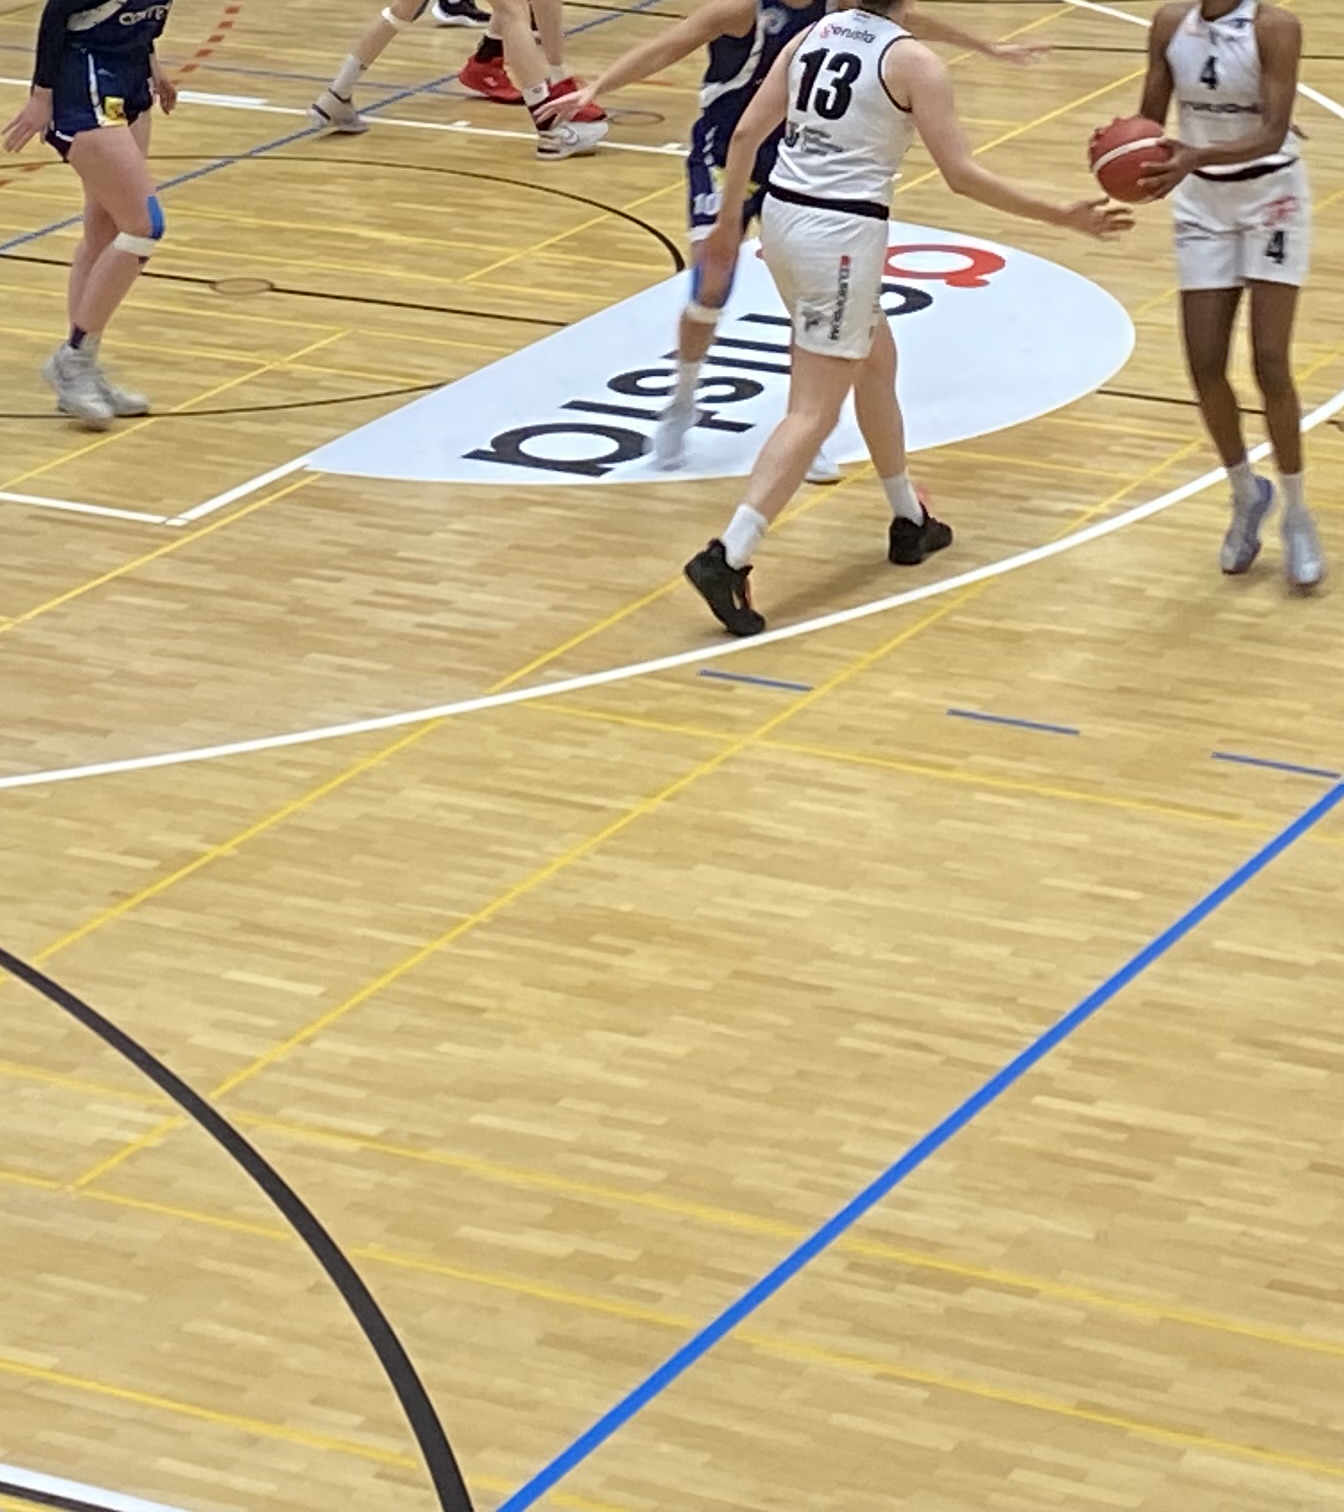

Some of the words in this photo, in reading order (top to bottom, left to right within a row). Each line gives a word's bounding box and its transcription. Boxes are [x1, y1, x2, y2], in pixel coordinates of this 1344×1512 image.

[795, 47, 863, 121] 13
[1199, 55, 1219, 90] 4
[1264, 230, 1286, 265] 4
